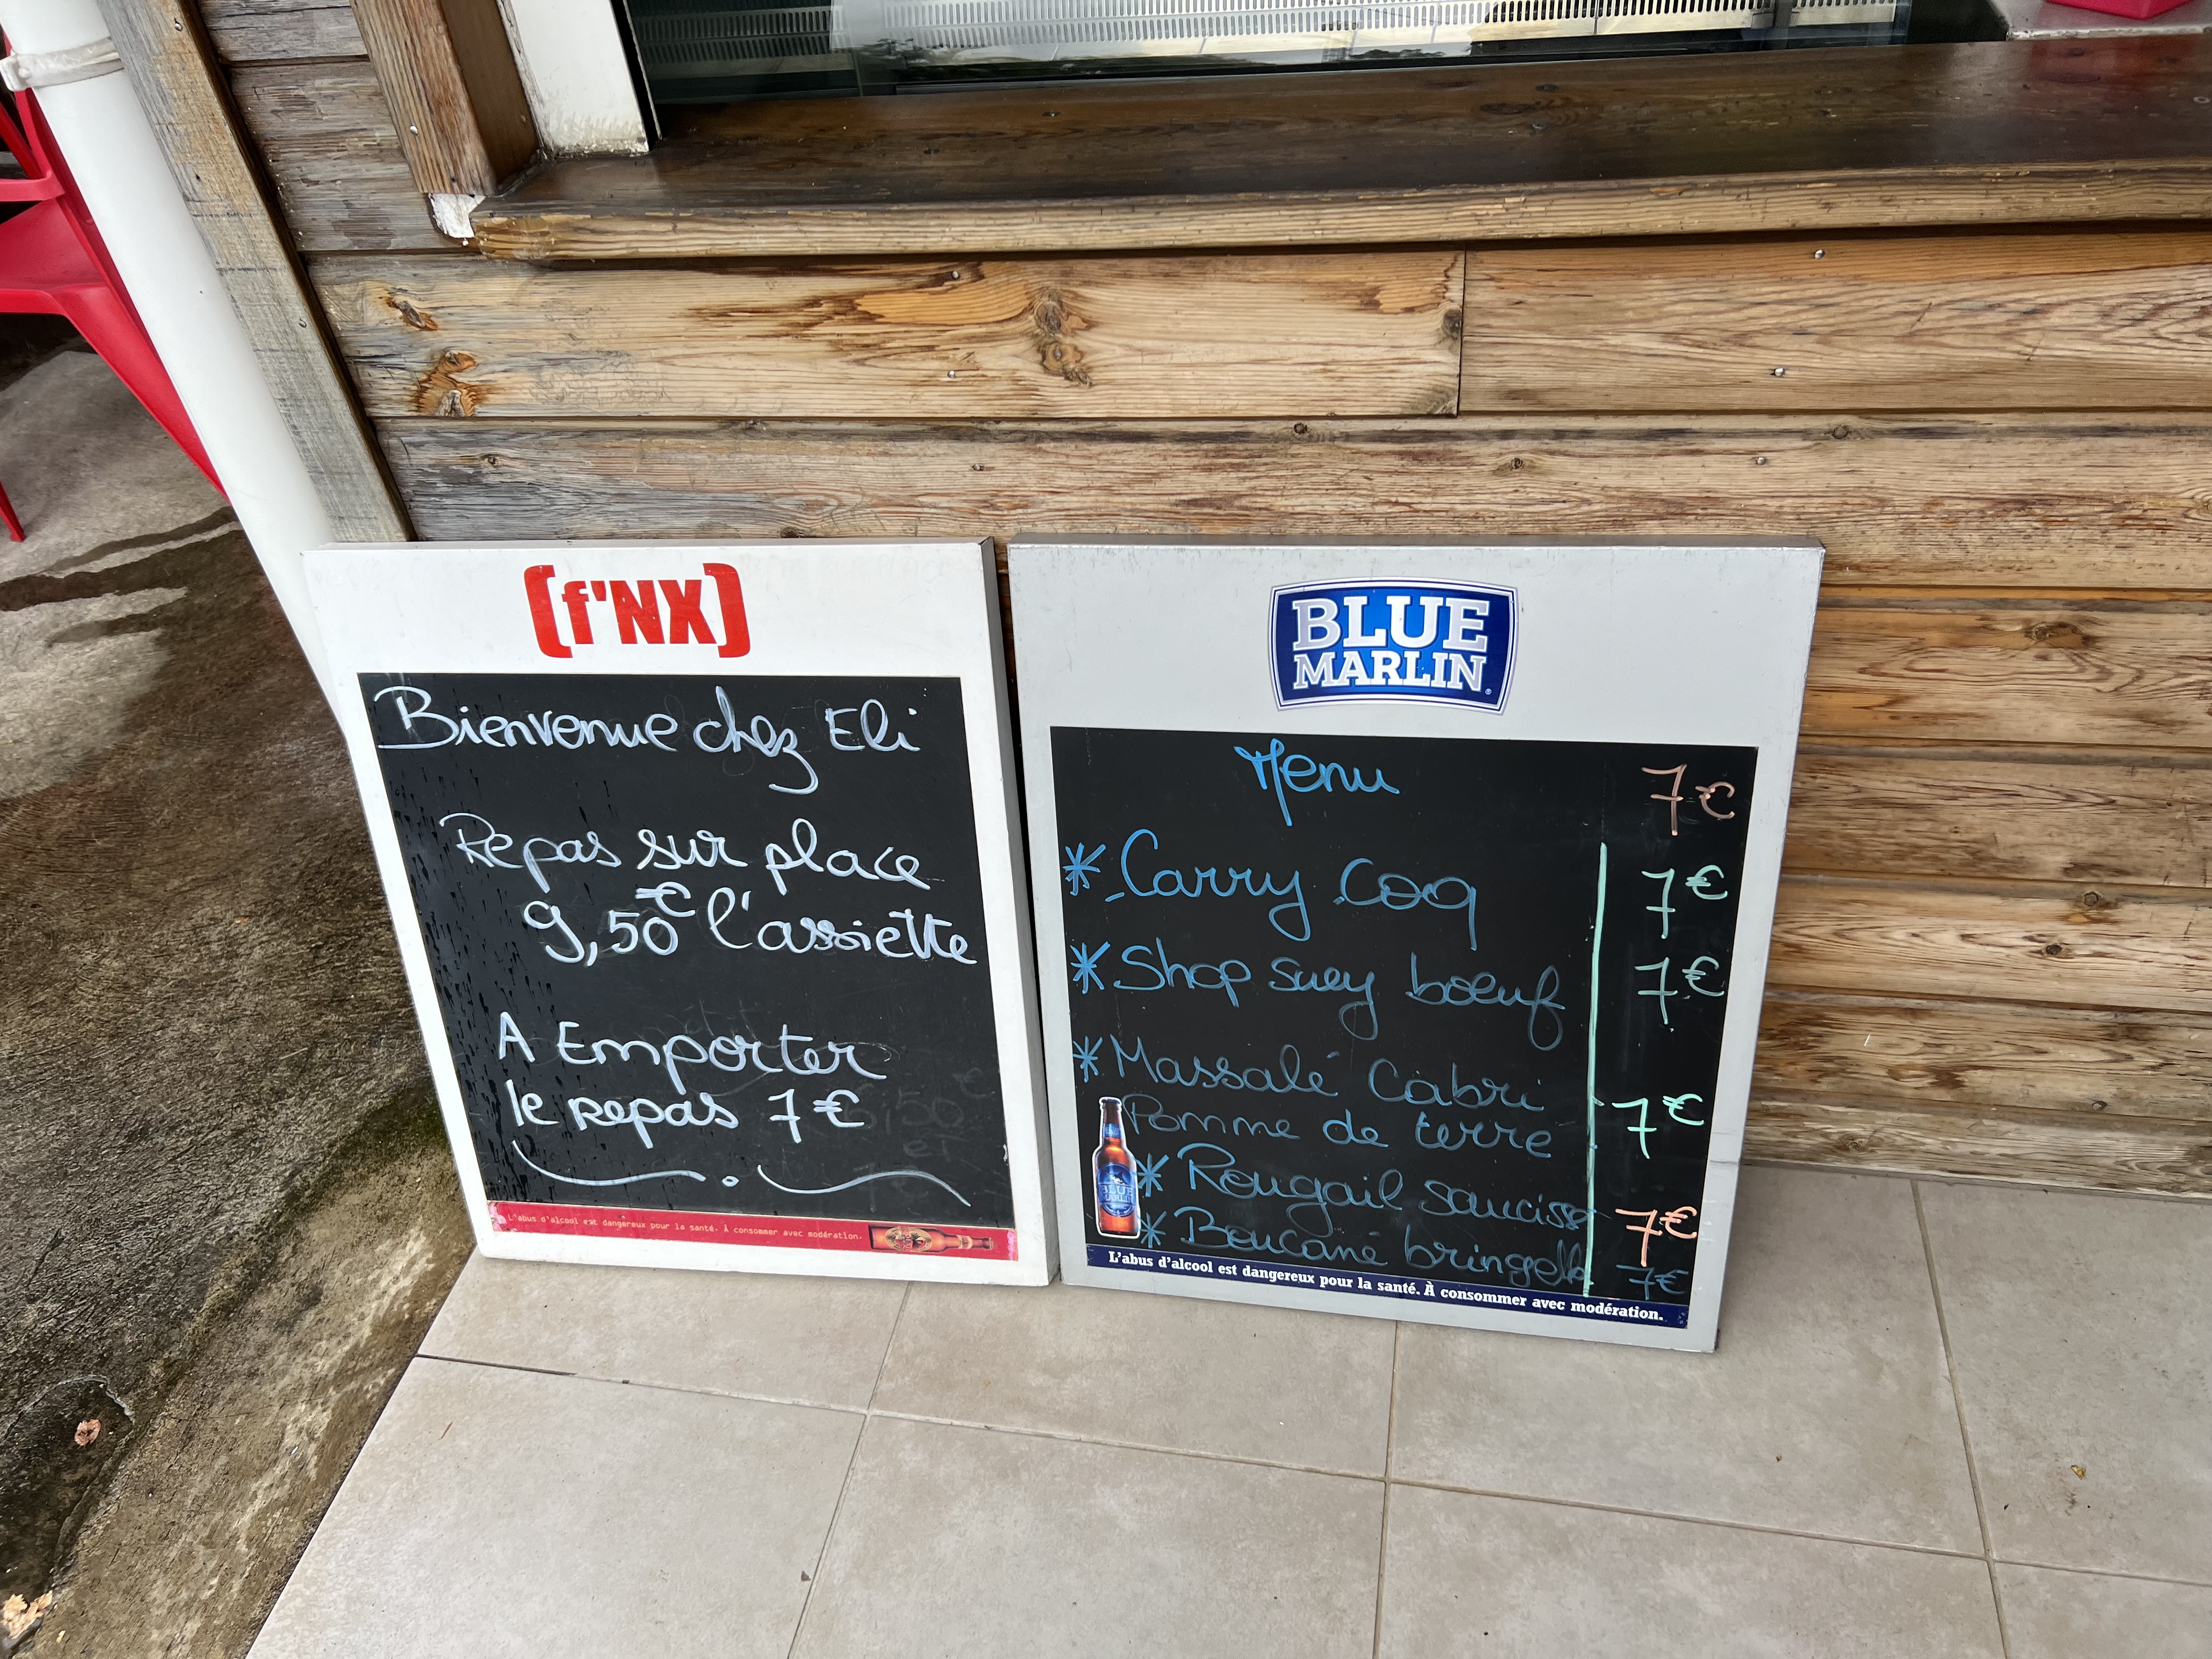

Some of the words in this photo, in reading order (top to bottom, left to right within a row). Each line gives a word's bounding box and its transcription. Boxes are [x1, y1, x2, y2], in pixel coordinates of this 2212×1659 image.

[1291, 595, 1490, 652] BLUE
[1292, 650, 1486, 691] MARLIN
[373, 686, 678, 751] Bienvenue
[693, 685, 819, 795] chez
[825, 699, 921, 752] Eli
[1234, 738, 1400, 826] Menu
[438, 812, 622, 894] Repas
[637, 828, 748, 870] sur
[765, 818, 931, 896] place
[1121, 828, 1310, 941] Carry
[1340, 857, 1477, 951] Coq
[707, 887, 978, 965] l'assiette
[1113, 937, 1251, 1008] Shop
[499, 1011, 536, 1063] A
[557, 1021, 887, 1095] Emporter
[1109, 1034, 1339, 1098] Massalé
[1368, 1058, 1545, 1109] Cabri
[505, 1079, 560, 1127] le
[1122, 1094, 1301, 1139] Pomme
[1322, 1108, 1389, 1148] de
[1415, 1110, 1552, 1158] terre
[1102, 1185, 1133, 1195] BLUE
[1177, 1143, 1404, 1238] Rougail
[507, 1214, 537, 1223] L'abus
[540, 1215, 579, 1225] d'alcool
[602, 1219, 646, 1230] dangereux
[650, 1222, 670, 1231] pour
[675, 1222, 686, 1231] la
[689, 1224, 719, 1233] santé.
[723, 1224, 730, 1234] À
[733, 1227, 778, 1237] consommer
[783, 1229, 804, 1238] avec
[808, 1231, 864, 1241] modération.
[1108, 1250, 1153, 1267] L'abus
[1158, 1255, 1213, 1273] d'alcool
[1218, 1264, 1238, 1276] est
[1242, 1267, 1315, 1284] dangereux
[1319, 1274, 1353, 1289] pour
[1357, 1277, 1372, 1290] la
[1377, 1280, 1420, 1296] santé.
[1424, 1281, 1435, 1297] À
[1440, 1288, 1527, 1307] consommer
[1532, 1299, 1565, 1311] avec
[1571, 1302, 1663, 1321] modération.
